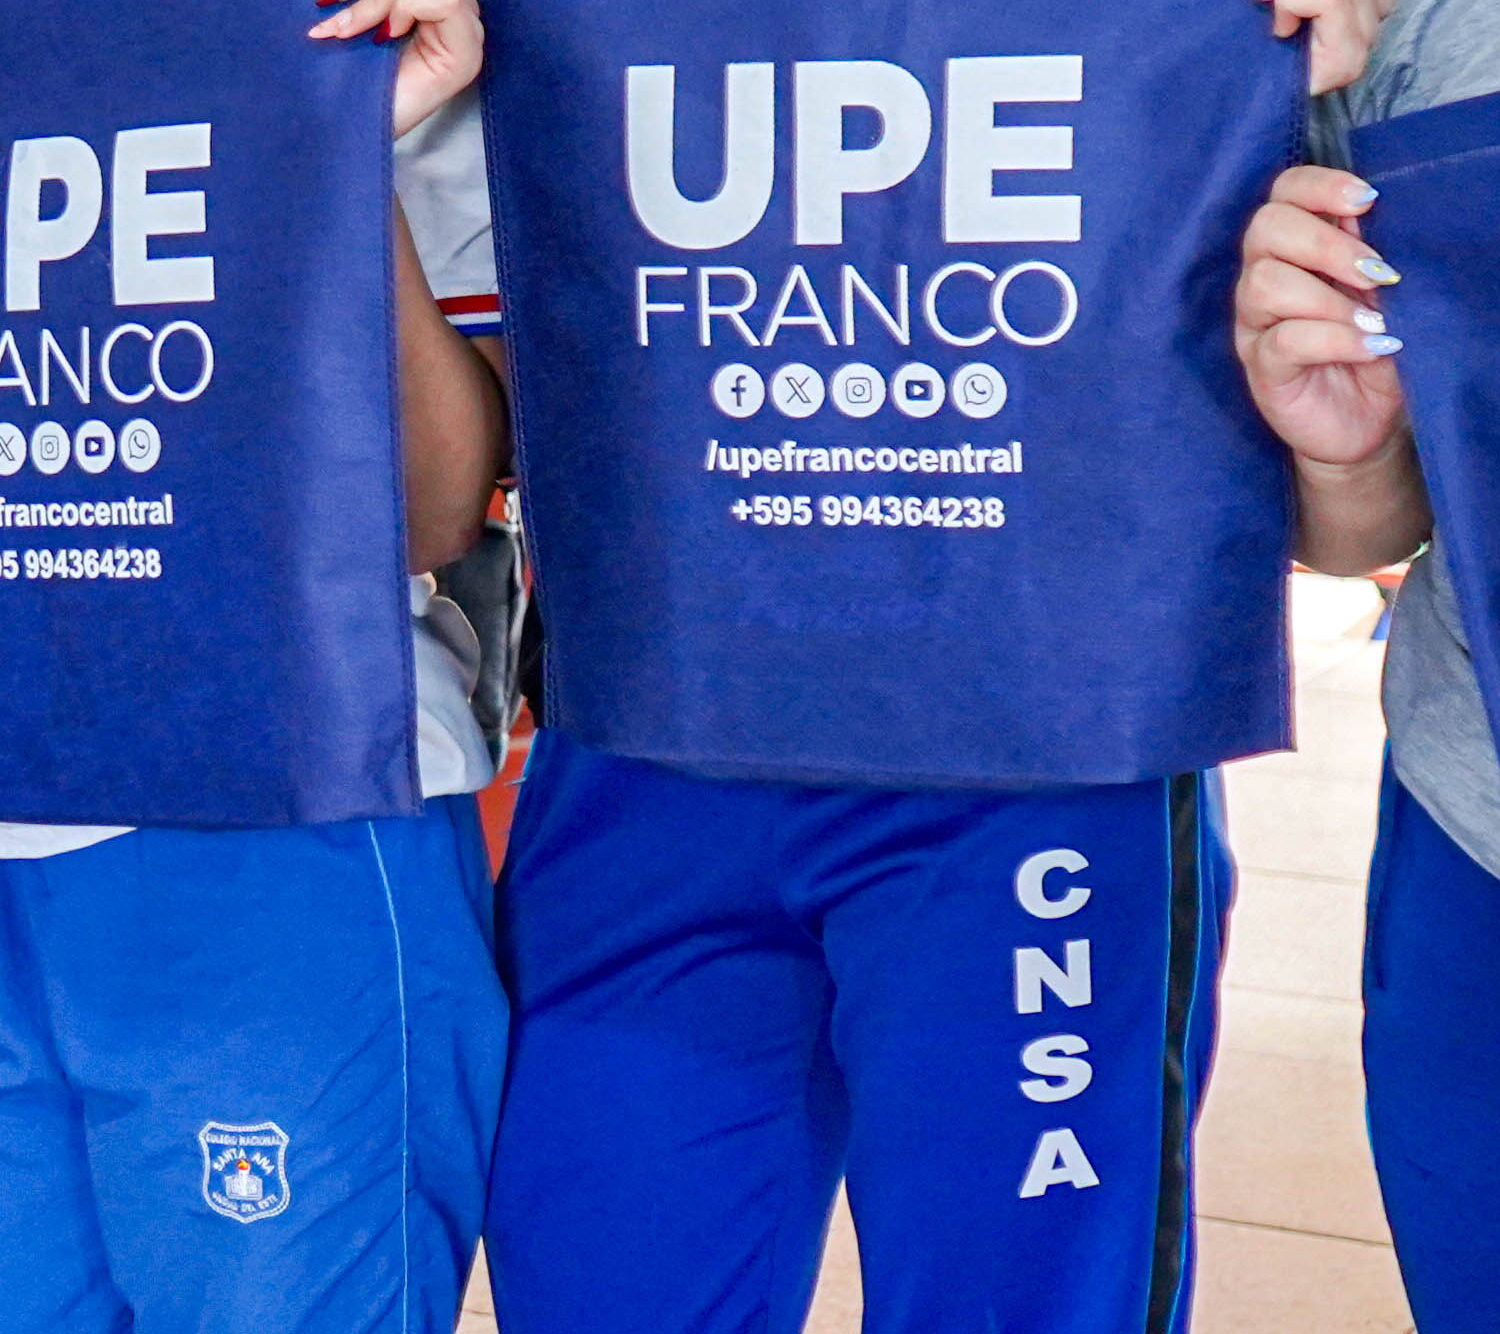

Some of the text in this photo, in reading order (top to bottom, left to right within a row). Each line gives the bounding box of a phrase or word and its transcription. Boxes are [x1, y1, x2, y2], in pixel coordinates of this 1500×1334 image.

[625, 55, 1083, 250] UPE
[637, 261, 1078, 347] FRANCO
[706, 440, 1023, 479] /upefrancocentral
[731, 495, 1005, 528] +595 994364238
[24, 547, 162, 579] 994364238
[1014, 848, 1101, 1200] CNSA
